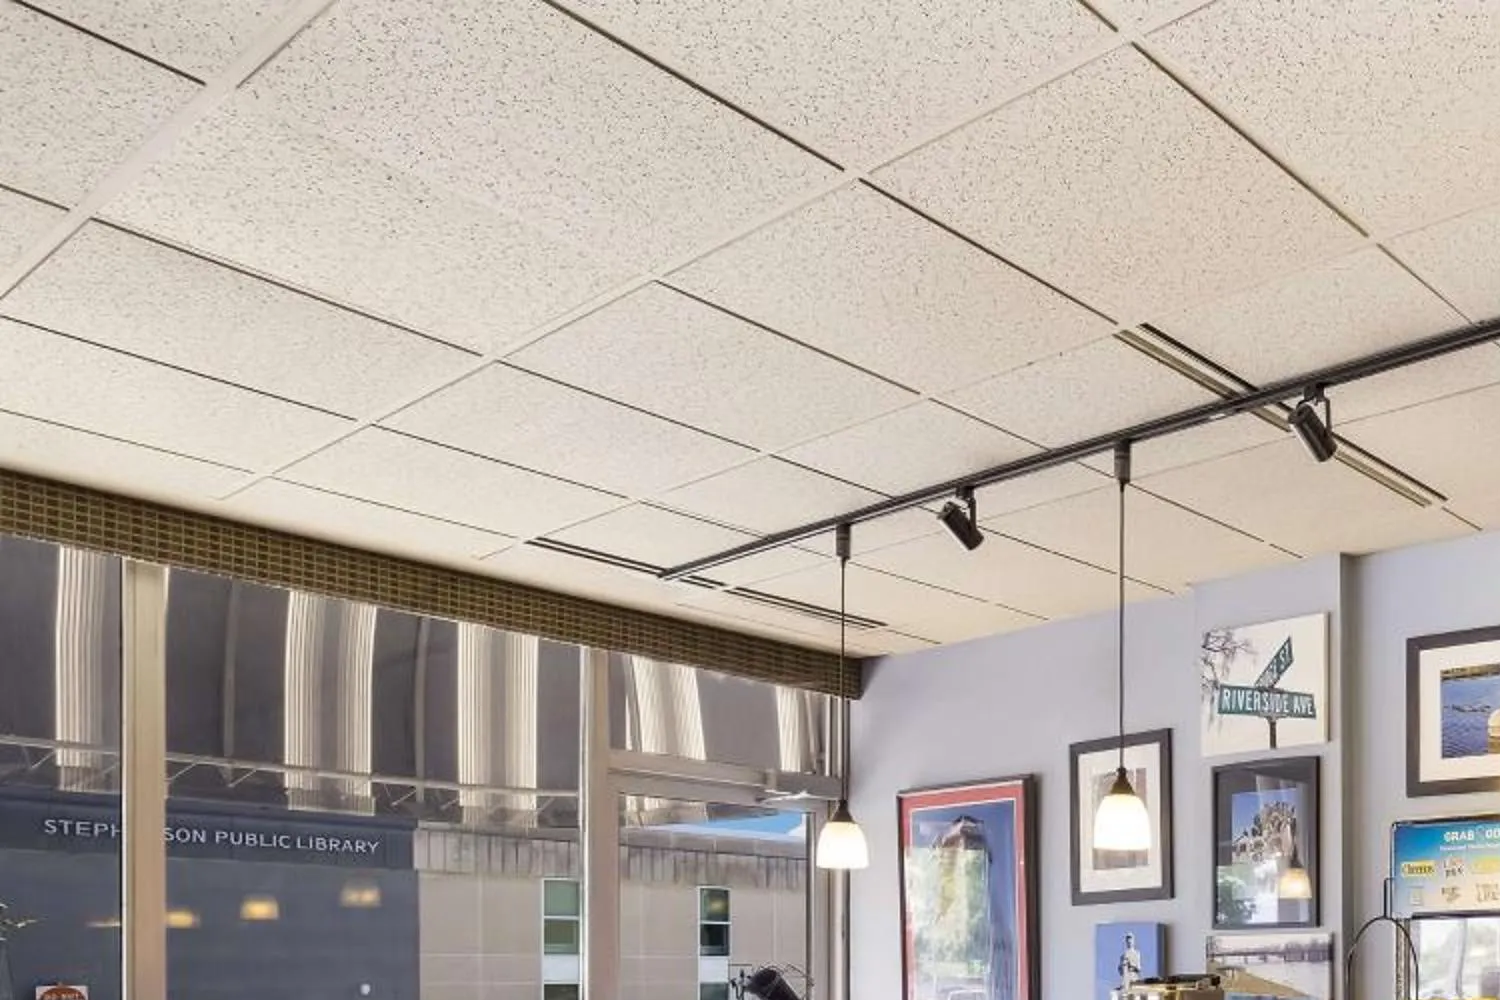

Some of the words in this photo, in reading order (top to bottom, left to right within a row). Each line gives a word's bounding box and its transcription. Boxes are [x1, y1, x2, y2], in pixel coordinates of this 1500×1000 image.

[1221, 688, 1289, 713] RIVERSIDE
[1293, 694, 1313, 715] AVE
[44, 819, 207, 843] STEPHSON
[215, 830, 291, 849] PUBLIC
[296, 835, 380, 853] LIBRARY
[1443, 829, 1475, 842] GRAB
